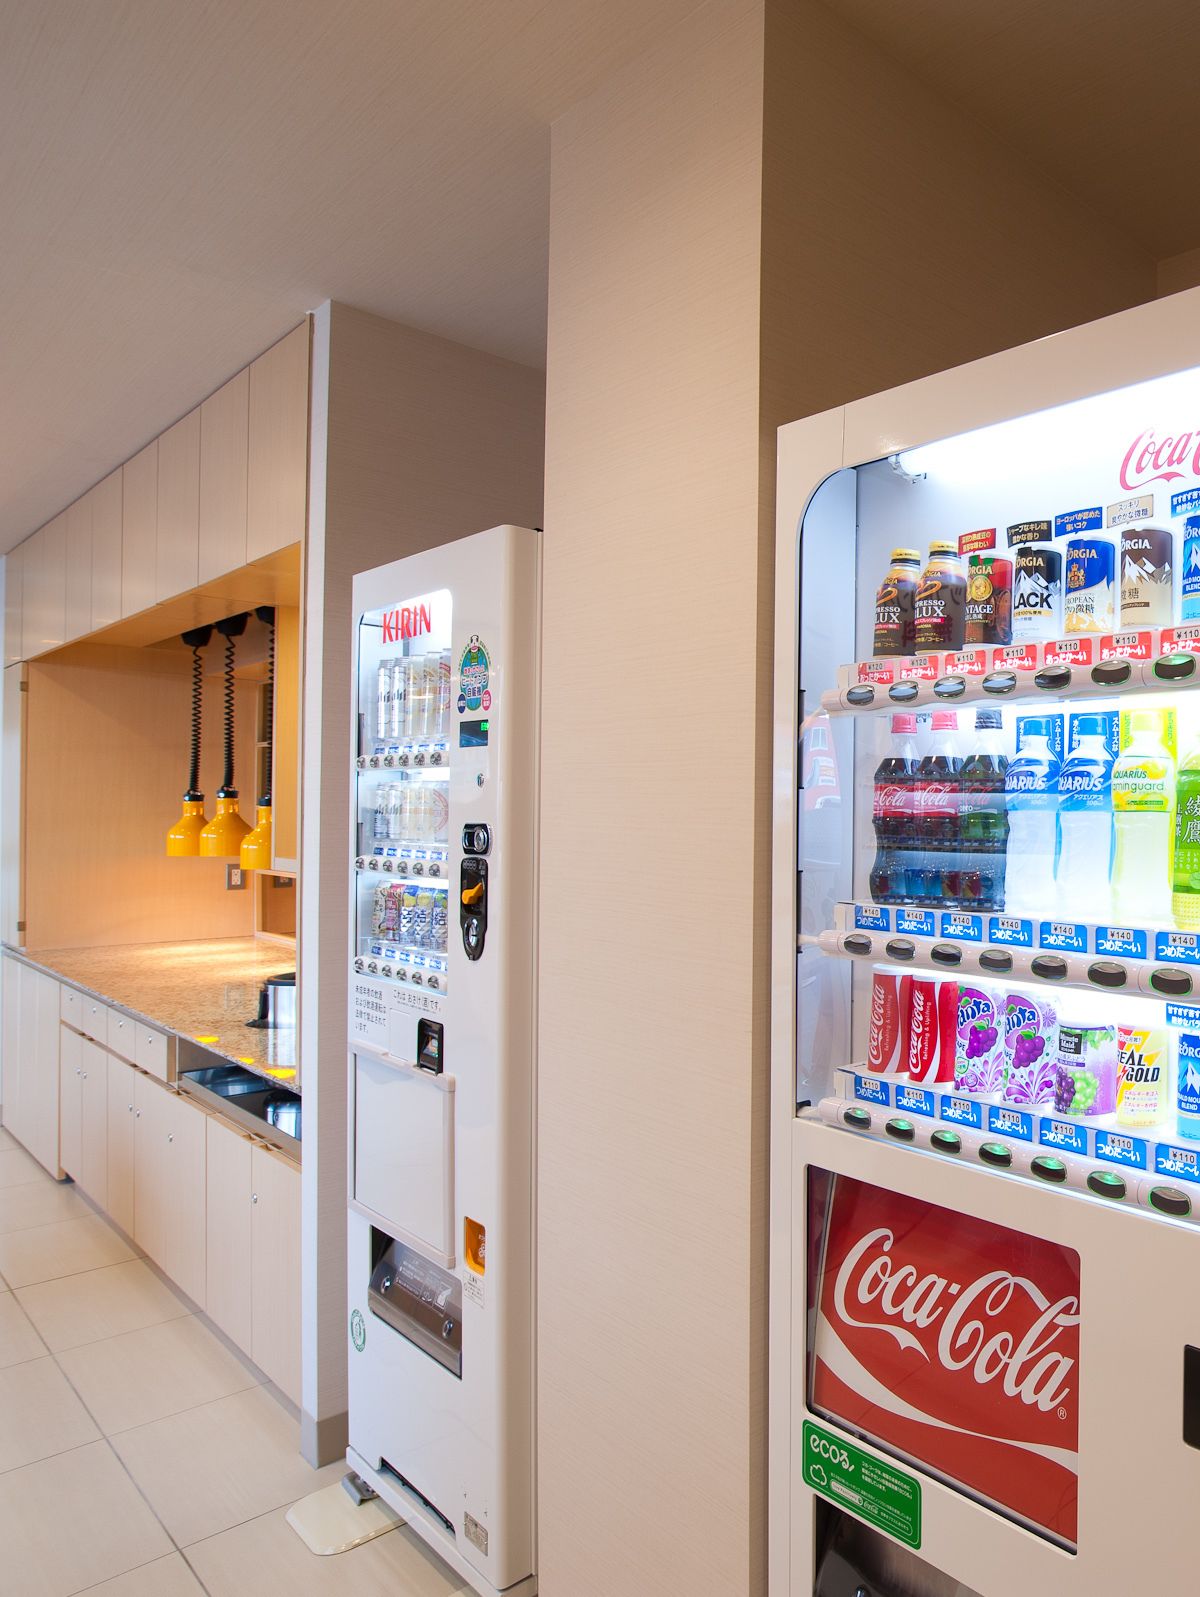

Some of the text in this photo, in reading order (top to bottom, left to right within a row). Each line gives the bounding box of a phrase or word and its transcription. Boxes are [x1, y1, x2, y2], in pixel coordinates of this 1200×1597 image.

[1119, 501, 1140, 512] スッキリ
[1112, 509, 1148, 524] 爽やかな微糖
[382, 602, 431, 644] KIRIN
[1176, 628, 1200, 639] ¥110
[1116, 636, 1137, 645] ¥110
[1058, 643, 1078, 652] ¥110
[957, 654, 974, 662] ¥110
[1006, 649, 1024, 658] ¥110
[906, 912, 923, 921] ¥140
[953, 916, 970, 925] ¥140
[1001, 920, 1019, 930] ¥140
[1053, 925, 1073, 935] ¥140
[1110, 931, 1132, 940] ¥140
[1171, 936, 1195, 946] ¥140
[394, 989, 406, 1001] これは
[869, 984, 885, 1065] Coca-Cola
[909, 990, 925, 1074] Coca-Cola
[1126, 1067, 1160, 1083] GOLD
[906, 1091, 923, 1100] ¥110
[953, 1101, 970, 1111] ¥110
[1001, 1112, 1020, 1123] ¥110
[1054, 1124, 1074, 1135] ¥110
[1110, 1137, 1132, 1149] ¥110
[1171, 1151, 1195, 1163] ¥110
[833, 1227, 1081, 1413] Coca-Cola
